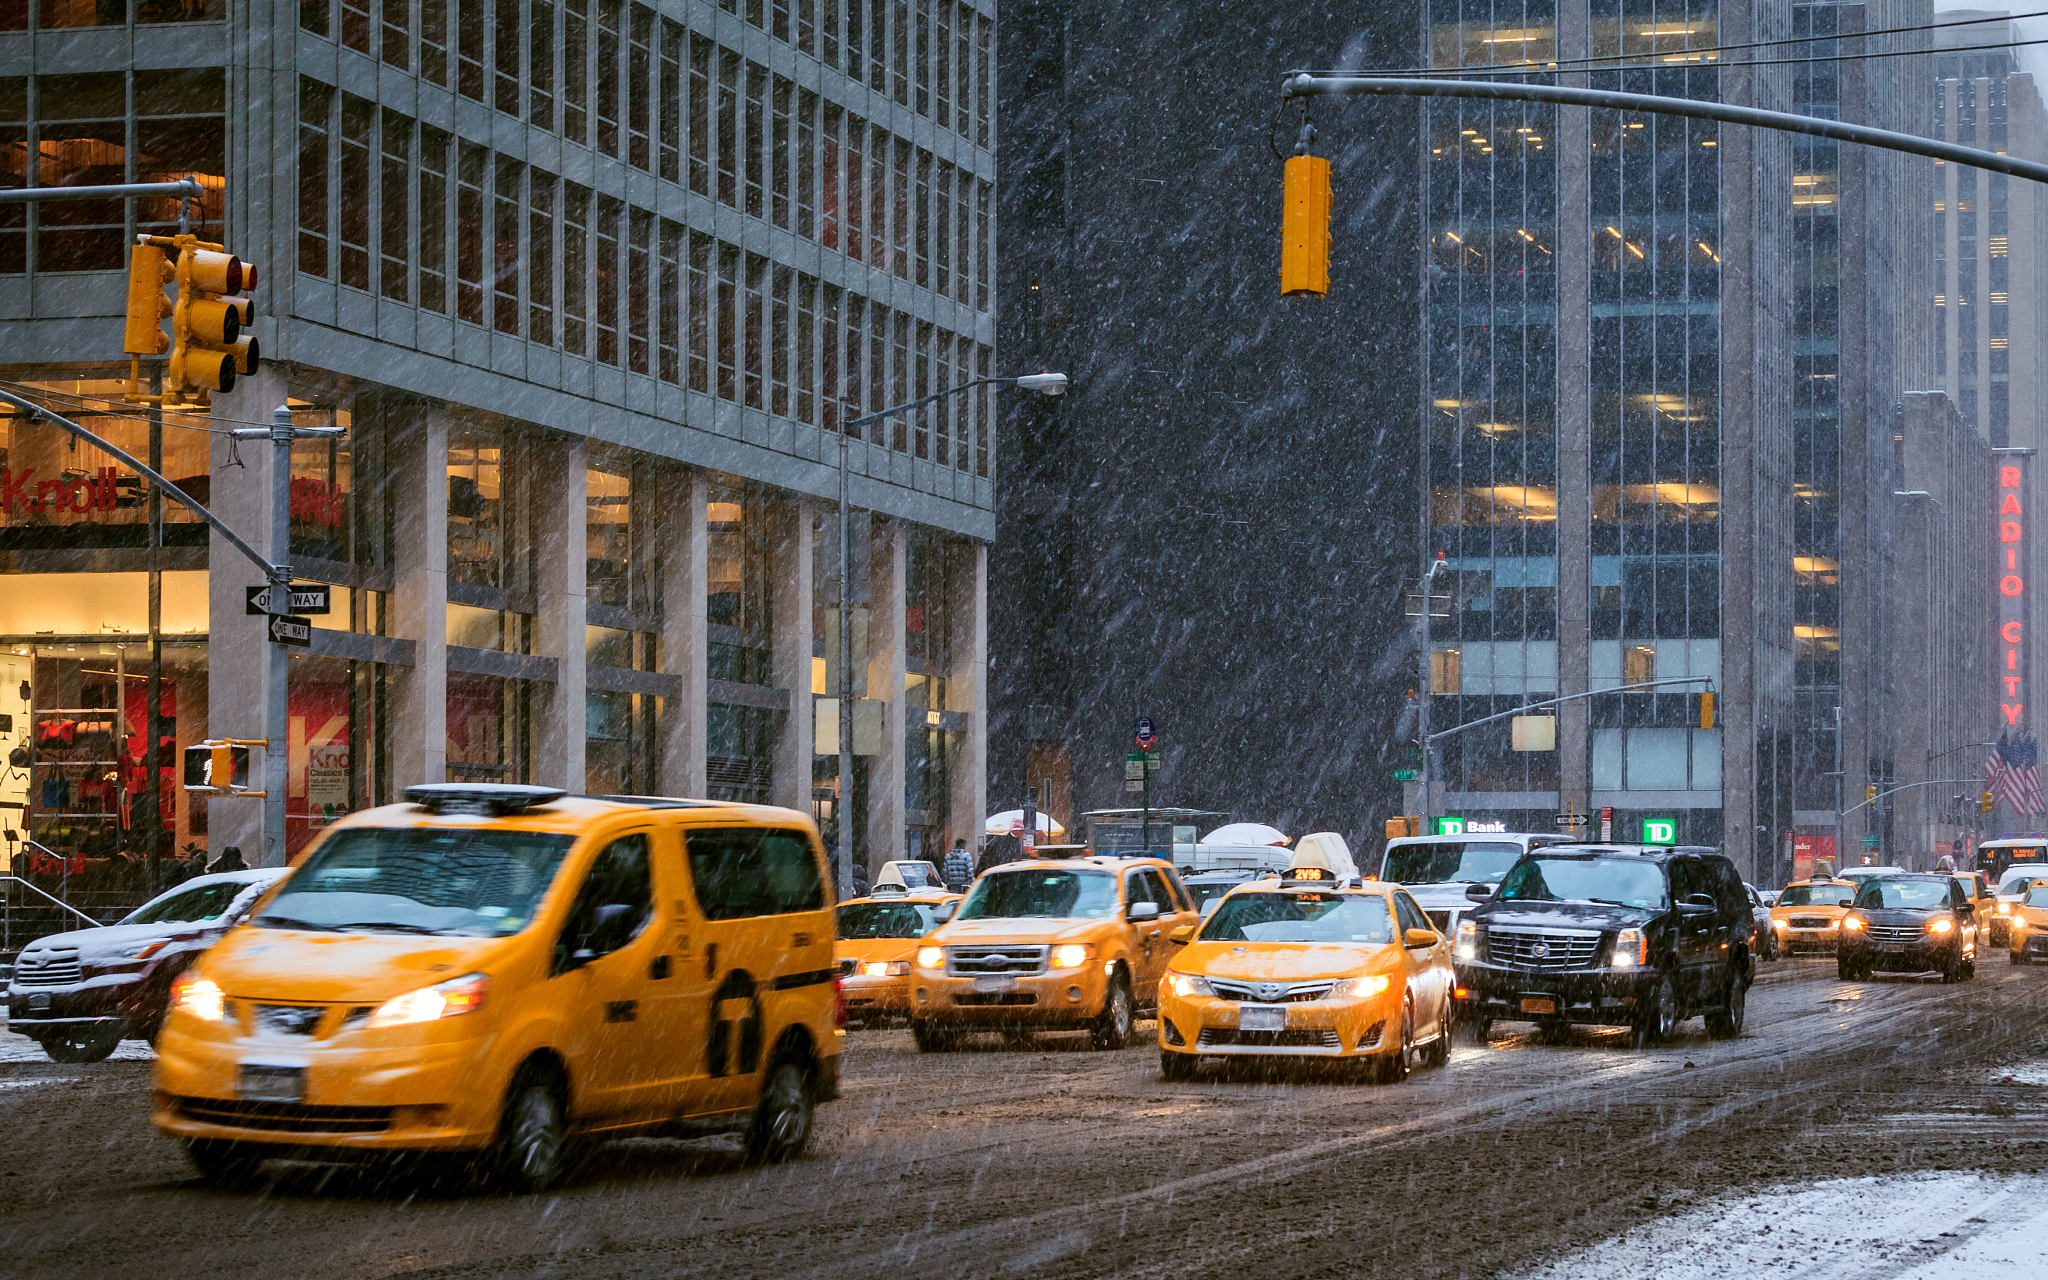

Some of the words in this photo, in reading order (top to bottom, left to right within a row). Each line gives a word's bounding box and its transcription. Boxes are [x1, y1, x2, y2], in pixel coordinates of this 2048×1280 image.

[2, 467, 117, 514] Knoll
[2000, 466, 2023, 597] RADIO
[293, 594, 319, 606] WAY
[274, 622, 287, 635] ONE
[292, 625, 306, 638] WAY
[2001, 621, 2023, 725] CITY
[1441, 821, 1463, 835] TD
[1467, 821, 1506, 833] Bank
[1646, 823, 1673, 842] TD
[29, 851, 86, 875] Knoll
[1294, 868, 1322, 881] 2V96
